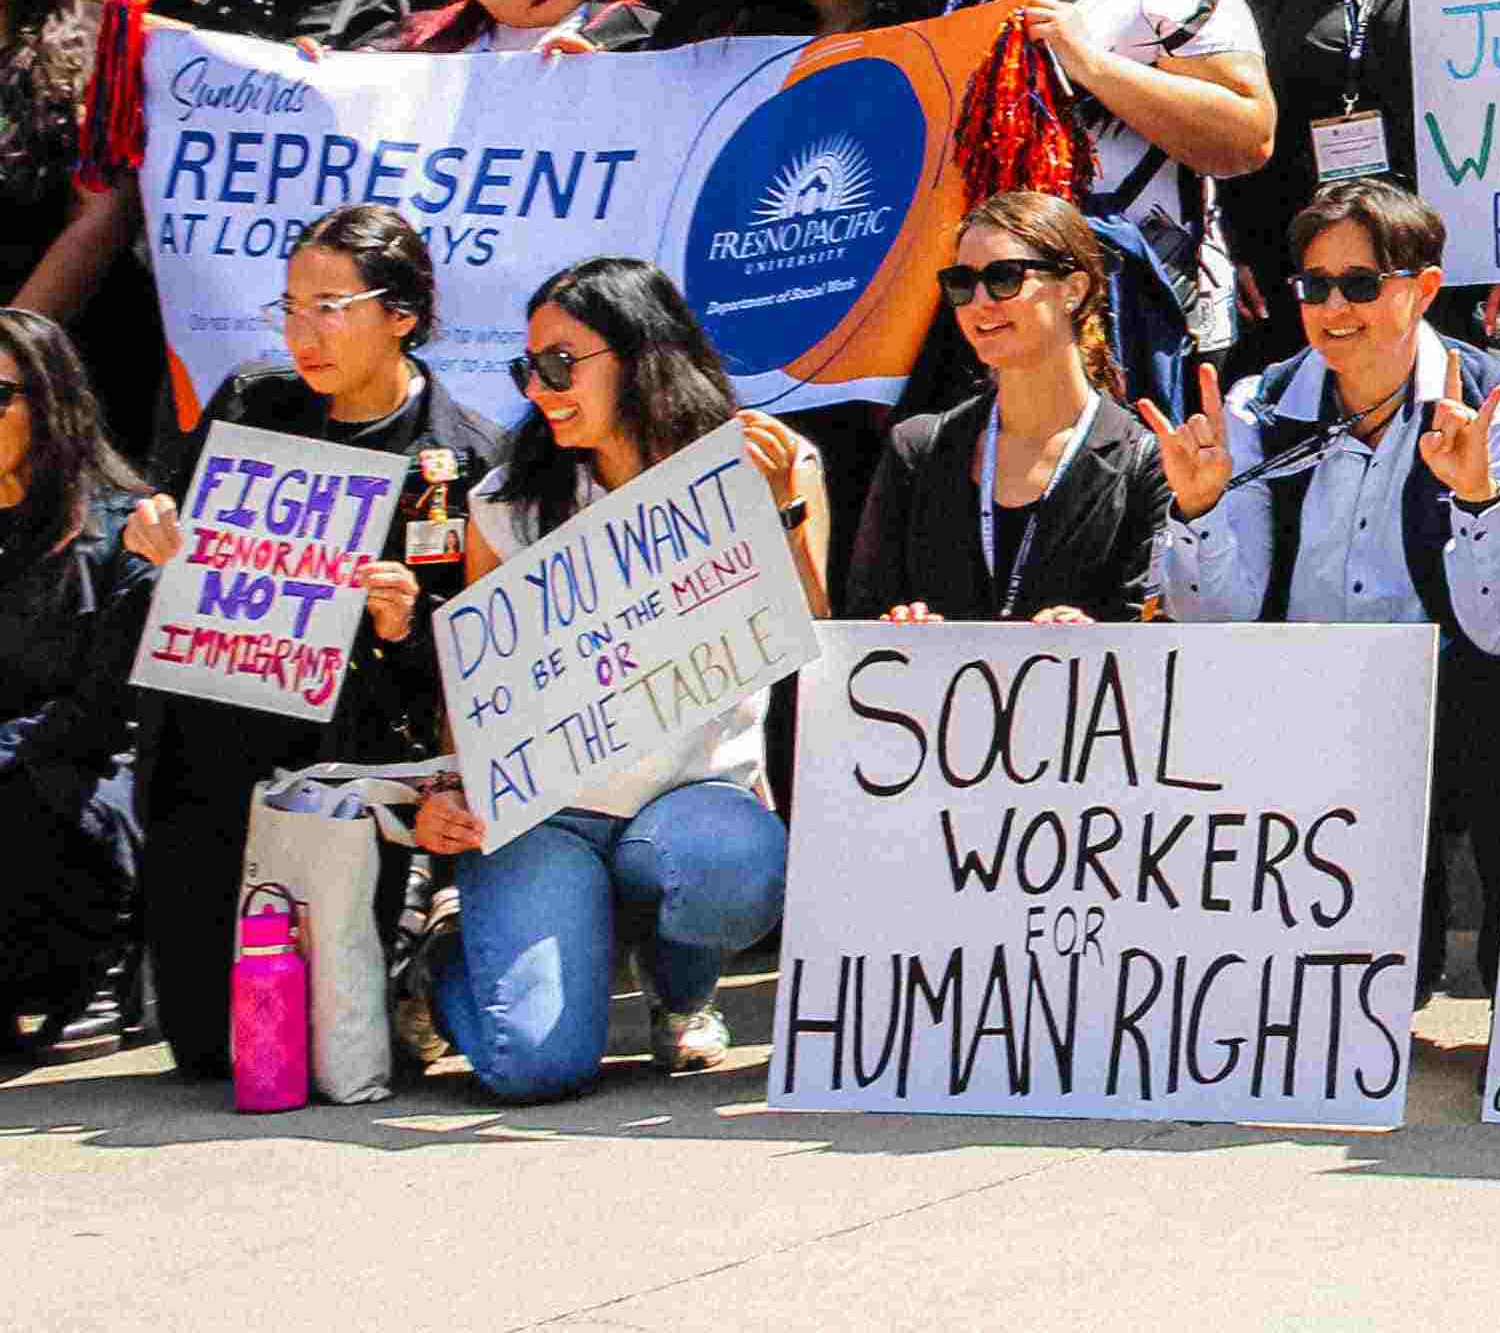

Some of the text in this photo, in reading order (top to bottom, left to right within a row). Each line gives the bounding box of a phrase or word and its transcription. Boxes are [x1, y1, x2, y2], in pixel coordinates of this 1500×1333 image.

[169, 57, 309, 121] Sunbirds
[165, 130, 636, 221] REPRESENT
[159, 213, 208, 255] AT
[709, 206, 892, 260] FRESNO PACIFIC
[744, 247, 848, 276] UNIVERSITY
[706, 294, 776, 316] Department
[827, 277, 856, 293] Work
[192, 455, 392, 552] FIGHT
[186, 527, 372, 588] IGNORANCE
[448, 457, 742, 681] DO YOU WANT
[197, 570, 336, 639] NOT
[531, 540, 754, 692] BE ON THE MENU
[597, 643, 639, 686] OR
[489, 605, 788, 821] AT THE TABLE
[846, 647, 1223, 797] SOCIAL
[940, 805, 1357, 929] WORKERS
[1025, 905, 1106, 965] FOR
[784, 944, 1407, 1102] HUMAN RIGHTS
